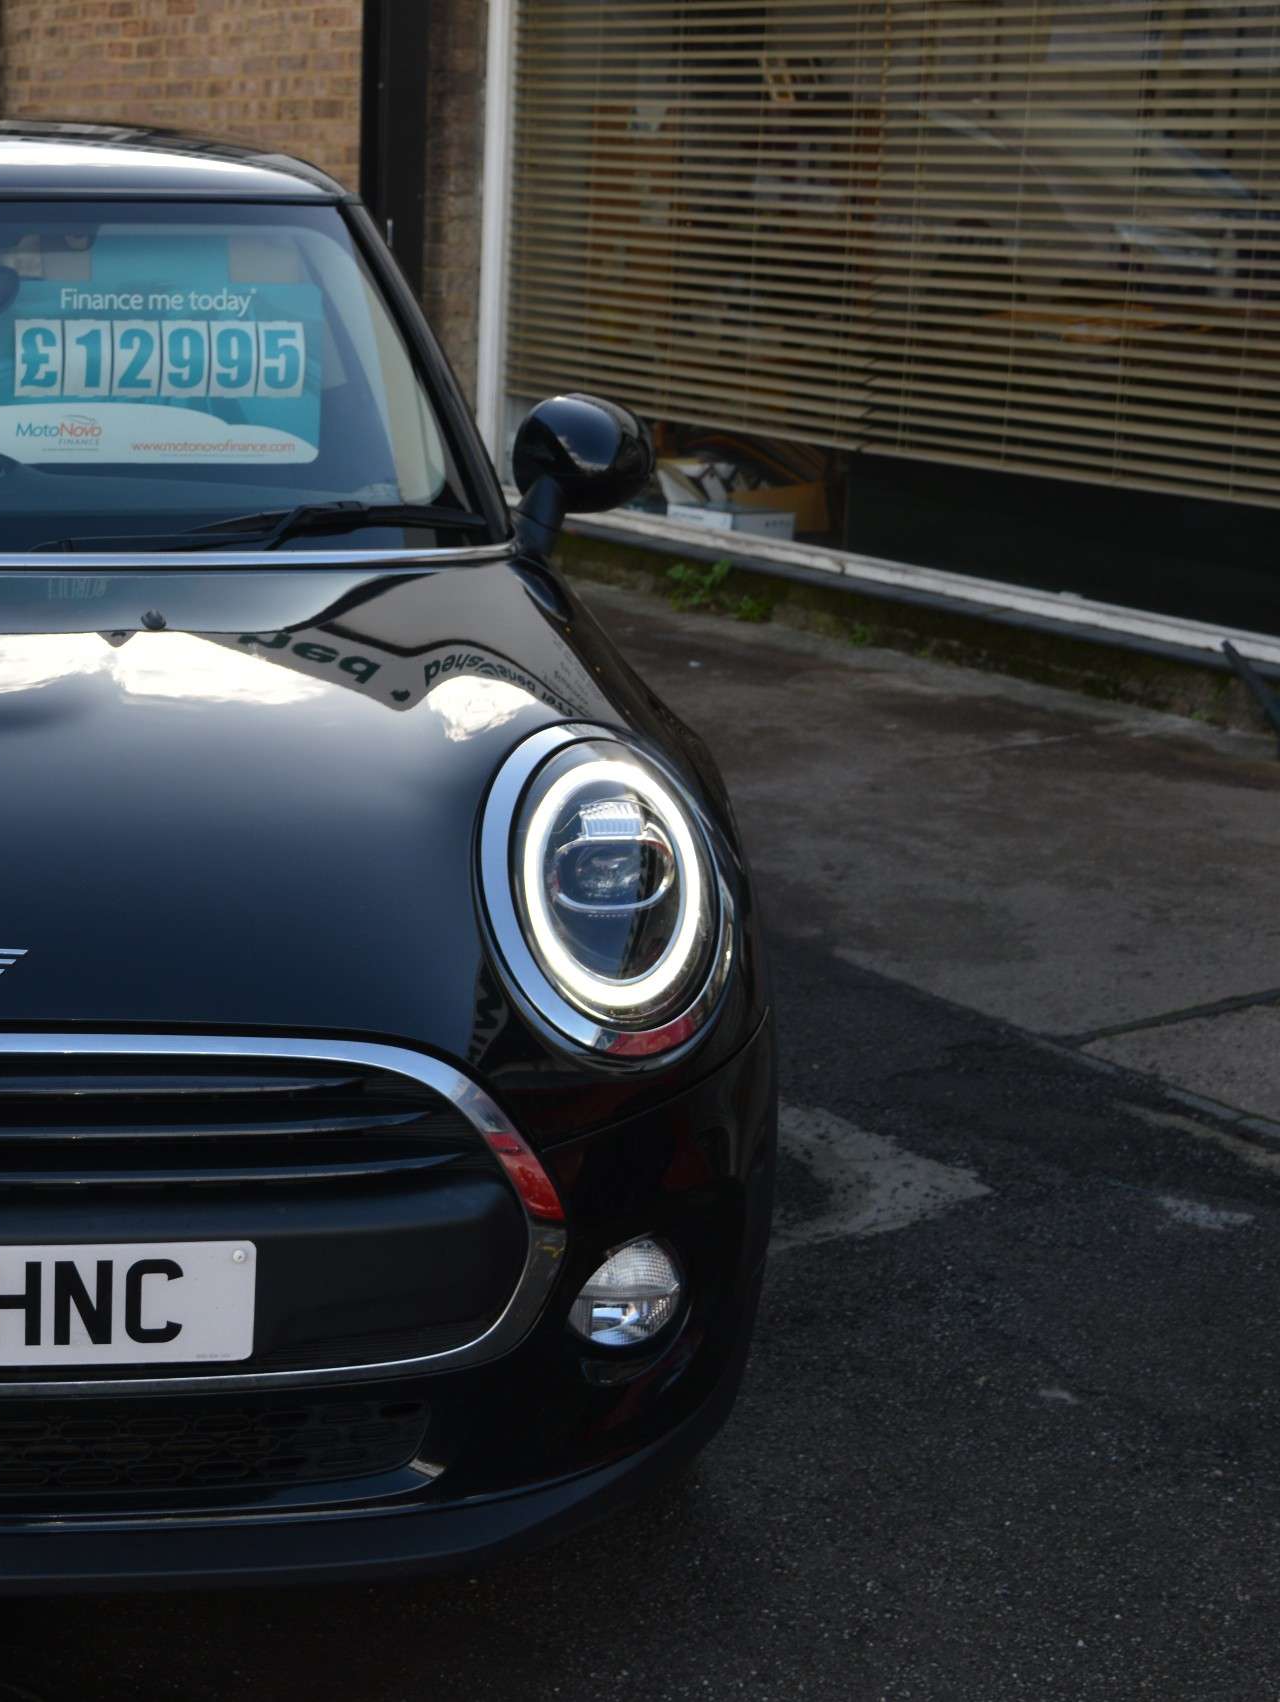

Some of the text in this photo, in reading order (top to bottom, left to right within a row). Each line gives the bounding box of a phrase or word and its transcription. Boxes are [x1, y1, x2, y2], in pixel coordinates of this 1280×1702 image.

[60, 288, 143, 310] Finance
[148, 294, 184, 310] me
[21, 326, 301, 391] £12995
[15, 422, 102, 438] MotoNovo
